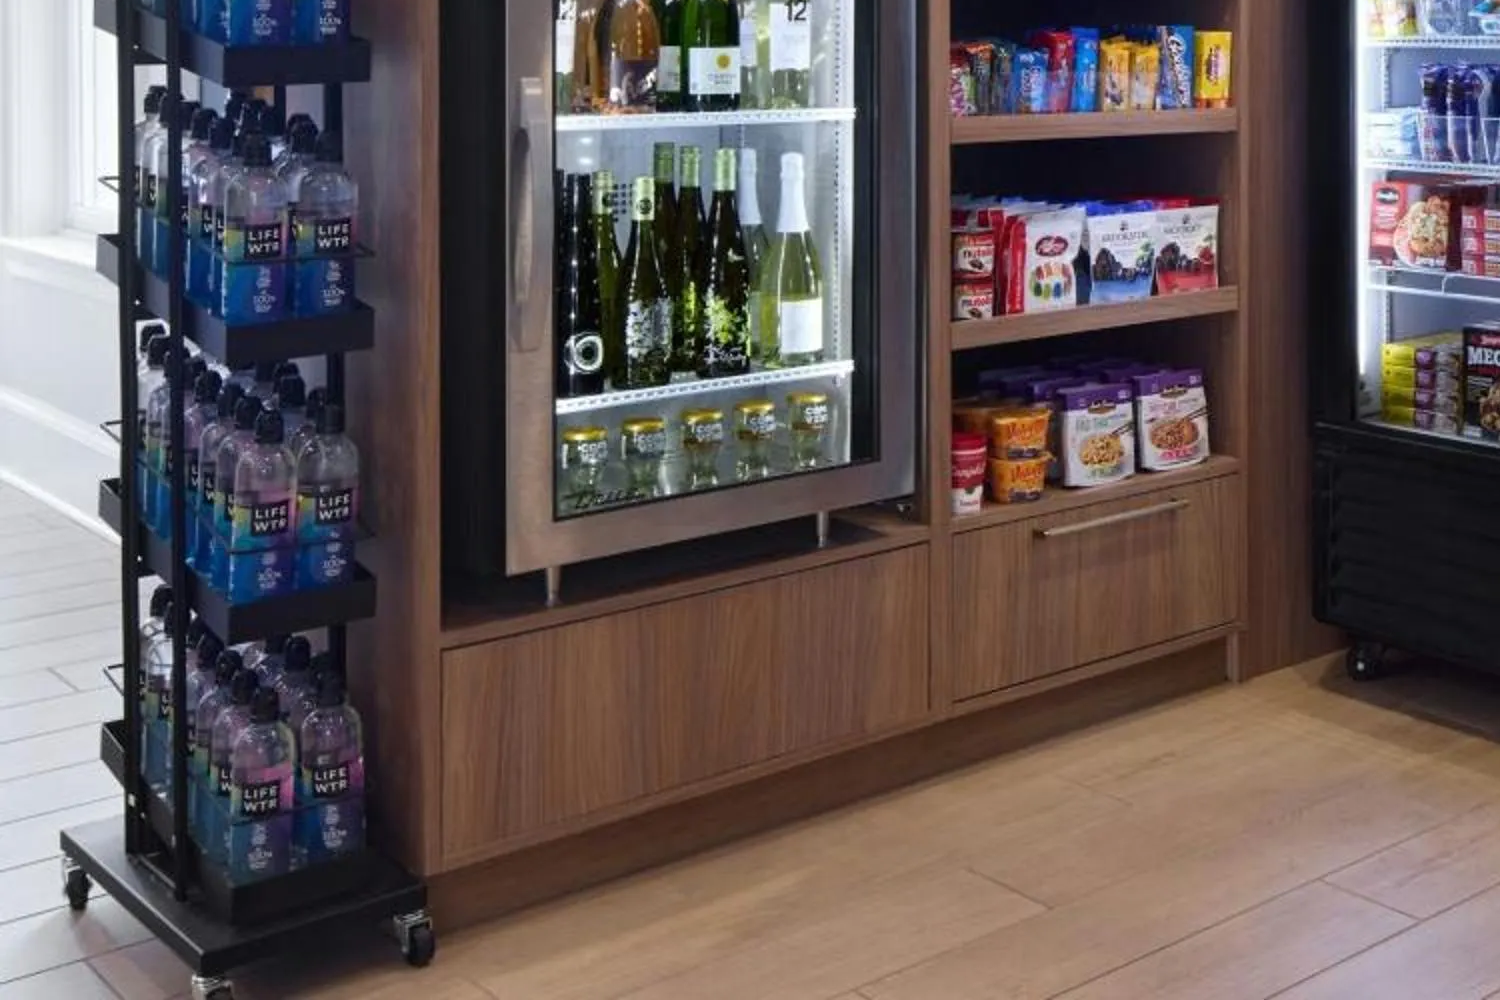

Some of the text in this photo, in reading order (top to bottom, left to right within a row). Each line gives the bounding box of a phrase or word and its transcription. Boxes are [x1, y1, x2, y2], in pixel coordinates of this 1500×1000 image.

[785, 0, 807, 21] 12
[248, 229, 280, 241] LIFE
[318, 223, 349, 236] LIFE
[248, 242, 281, 254] WTR
[317, 236, 349, 249] WTR
[318, 494, 350, 508] LIFE
[255, 506, 287, 519] LIFE
[318, 507, 349, 521] WTR
[253, 519, 288, 533] WTR
[314, 767, 346, 780] LIFE
[244, 786, 277, 799] LIFE
[315, 780, 348, 793] WTR
[243, 799, 277, 812] WTR
